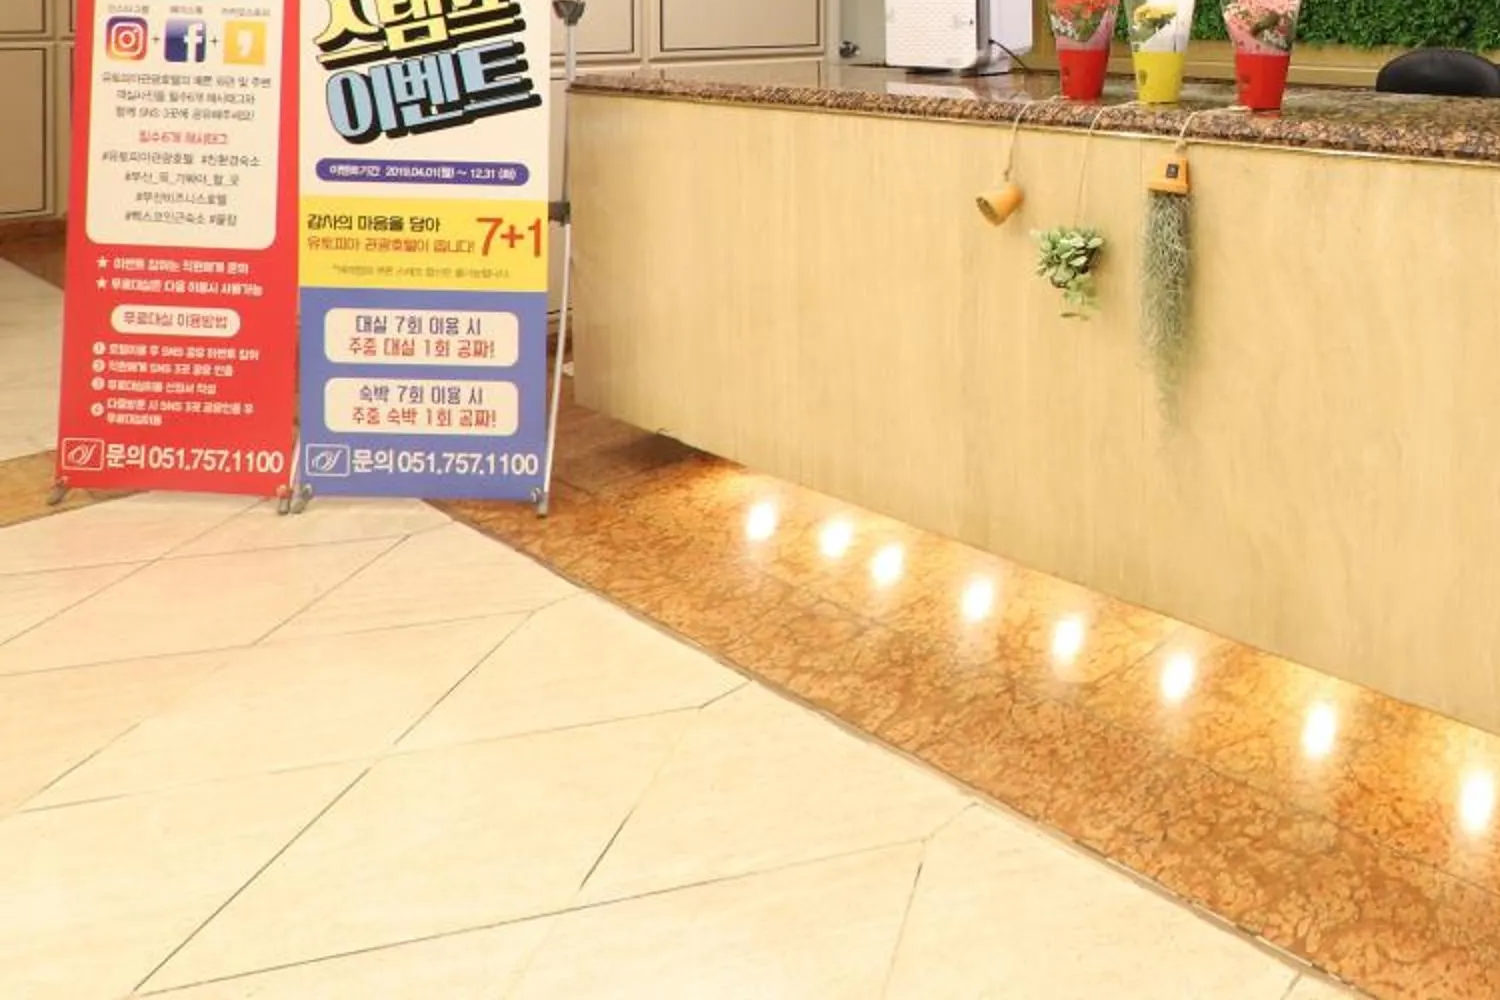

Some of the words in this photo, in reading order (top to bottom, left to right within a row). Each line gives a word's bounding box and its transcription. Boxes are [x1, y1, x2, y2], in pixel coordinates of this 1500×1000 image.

[325, 39, 542, 144] 이벤트
[307, 214, 354, 231] 감사의
[357, 215, 404, 232] 마음을
[410, 216, 441, 233] 담아
[476, 217, 542, 258] 7+1
[356, 316, 388, 334] 대실
[396, 315, 422, 334] 7회
[429, 316, 460, 336] 이용
[467, 318, 482, 336] 시
[350, 338, 377, 356] 주중
[384, 338, 416, 357] 대실
[457, 340, 496, 358] 공짜!
[359, 386, 390, 403] 숙박
[398, 386, 424, 404] 7회
[431, 386, 461, 405] 이용
[468, 388, 483, 405] 시
[352, 408, 381, 425] 주중
[387, 408, 418, 426] 숙박
[460, 410, 496, 428] 공짜!
[106, 444, 146, 469] 문의
[149, 446, 285, 473] 051.757.1100
[352, 448, 394, 474] 문의
[398, 452, 539, 476] 051.757.1100
